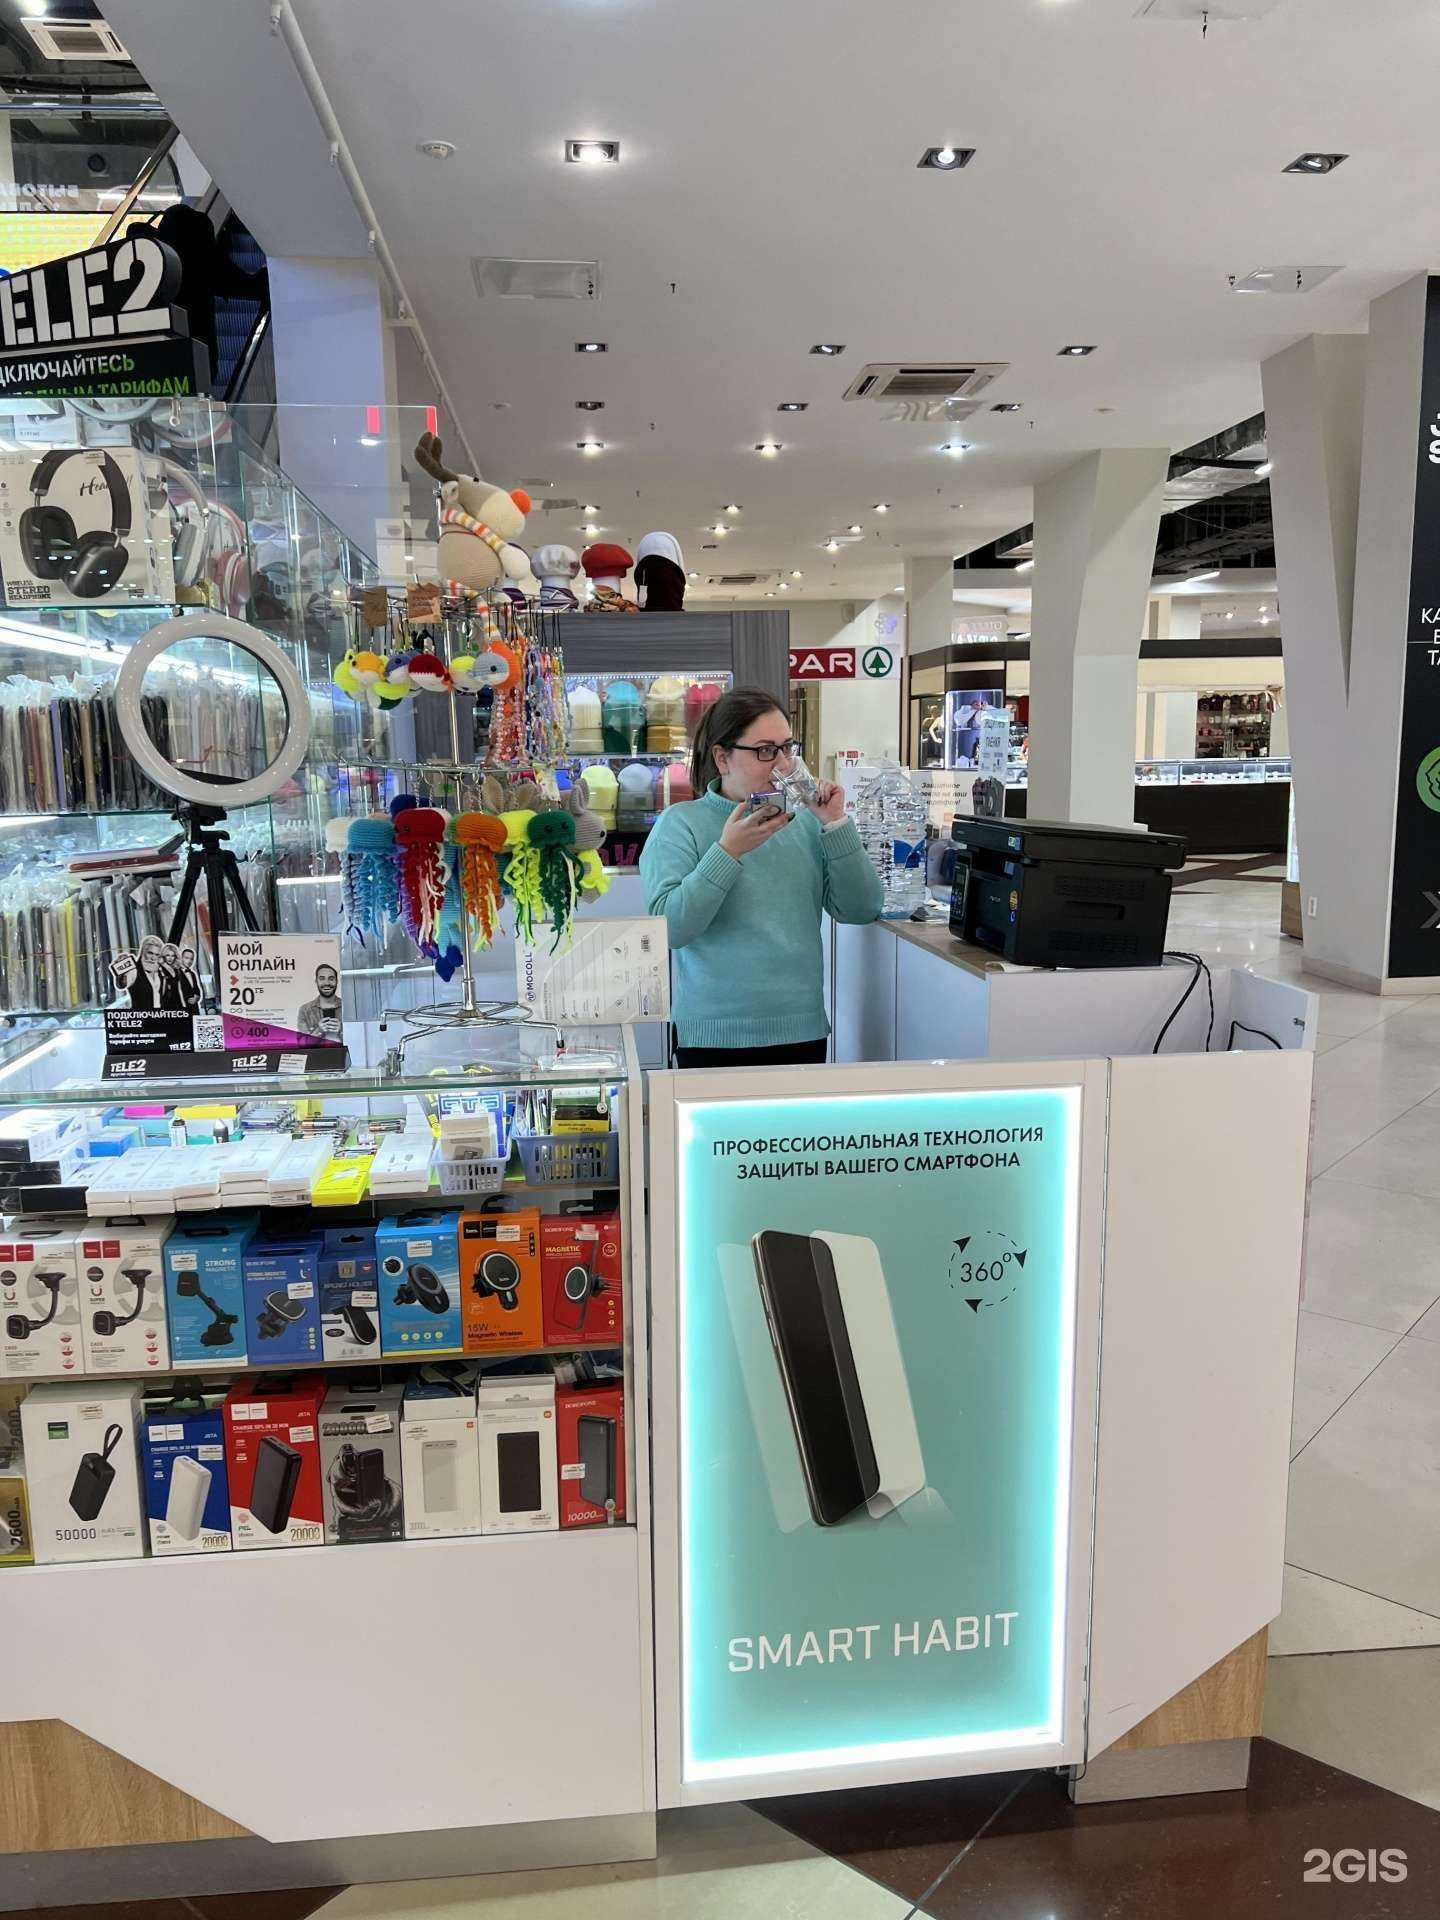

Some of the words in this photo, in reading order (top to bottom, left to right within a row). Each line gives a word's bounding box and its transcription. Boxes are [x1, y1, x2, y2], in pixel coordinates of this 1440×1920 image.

[8, 586, 50, 595] STEREO
[227, 940, 263, 956] МОЙ
[227, 956, 296, 972] ОНЛАЙН
[525, 951, 534, 991] MOCOLL
[230, 987, 255, 1006] 20
[107, 1010, 190, 1021] ПОДКЛЮЧАЙТЕСЬ
[119, 1020, 143, 1028] TELE2
[247, 1027, 270, 1038] 400
[169, 1042, 192, 1051] TELE2
[110, 1059, 147, 1073] TELE2
[231, 1054, 268, 1068] TELE2
[713, 1132, 919, 1156] ПРОФЕССИОНАЛЬНАЯ
[924, 1127, 1044, 1147] ТЕХНОЛОГИЯ
[737, 1161, 819, 1181] ЗАЩИТЫ
[824, 1157, 899, 1176] ВАШЕГО
[904, 1152, 1021, 1172] СМАРТФОНА
[545, 1245, 581, 1253] MAGNETIC
[205, 1259, 237, 1268] STRONG
[568, 1511, 598, 1522] 10000
[8, 1510, 24, 1547] 2600
[56, 1528, 97, 1541] 50000
[728, 1624, 881, 1673] SMART
[894, 1611, 1019, 1657] HABIT
